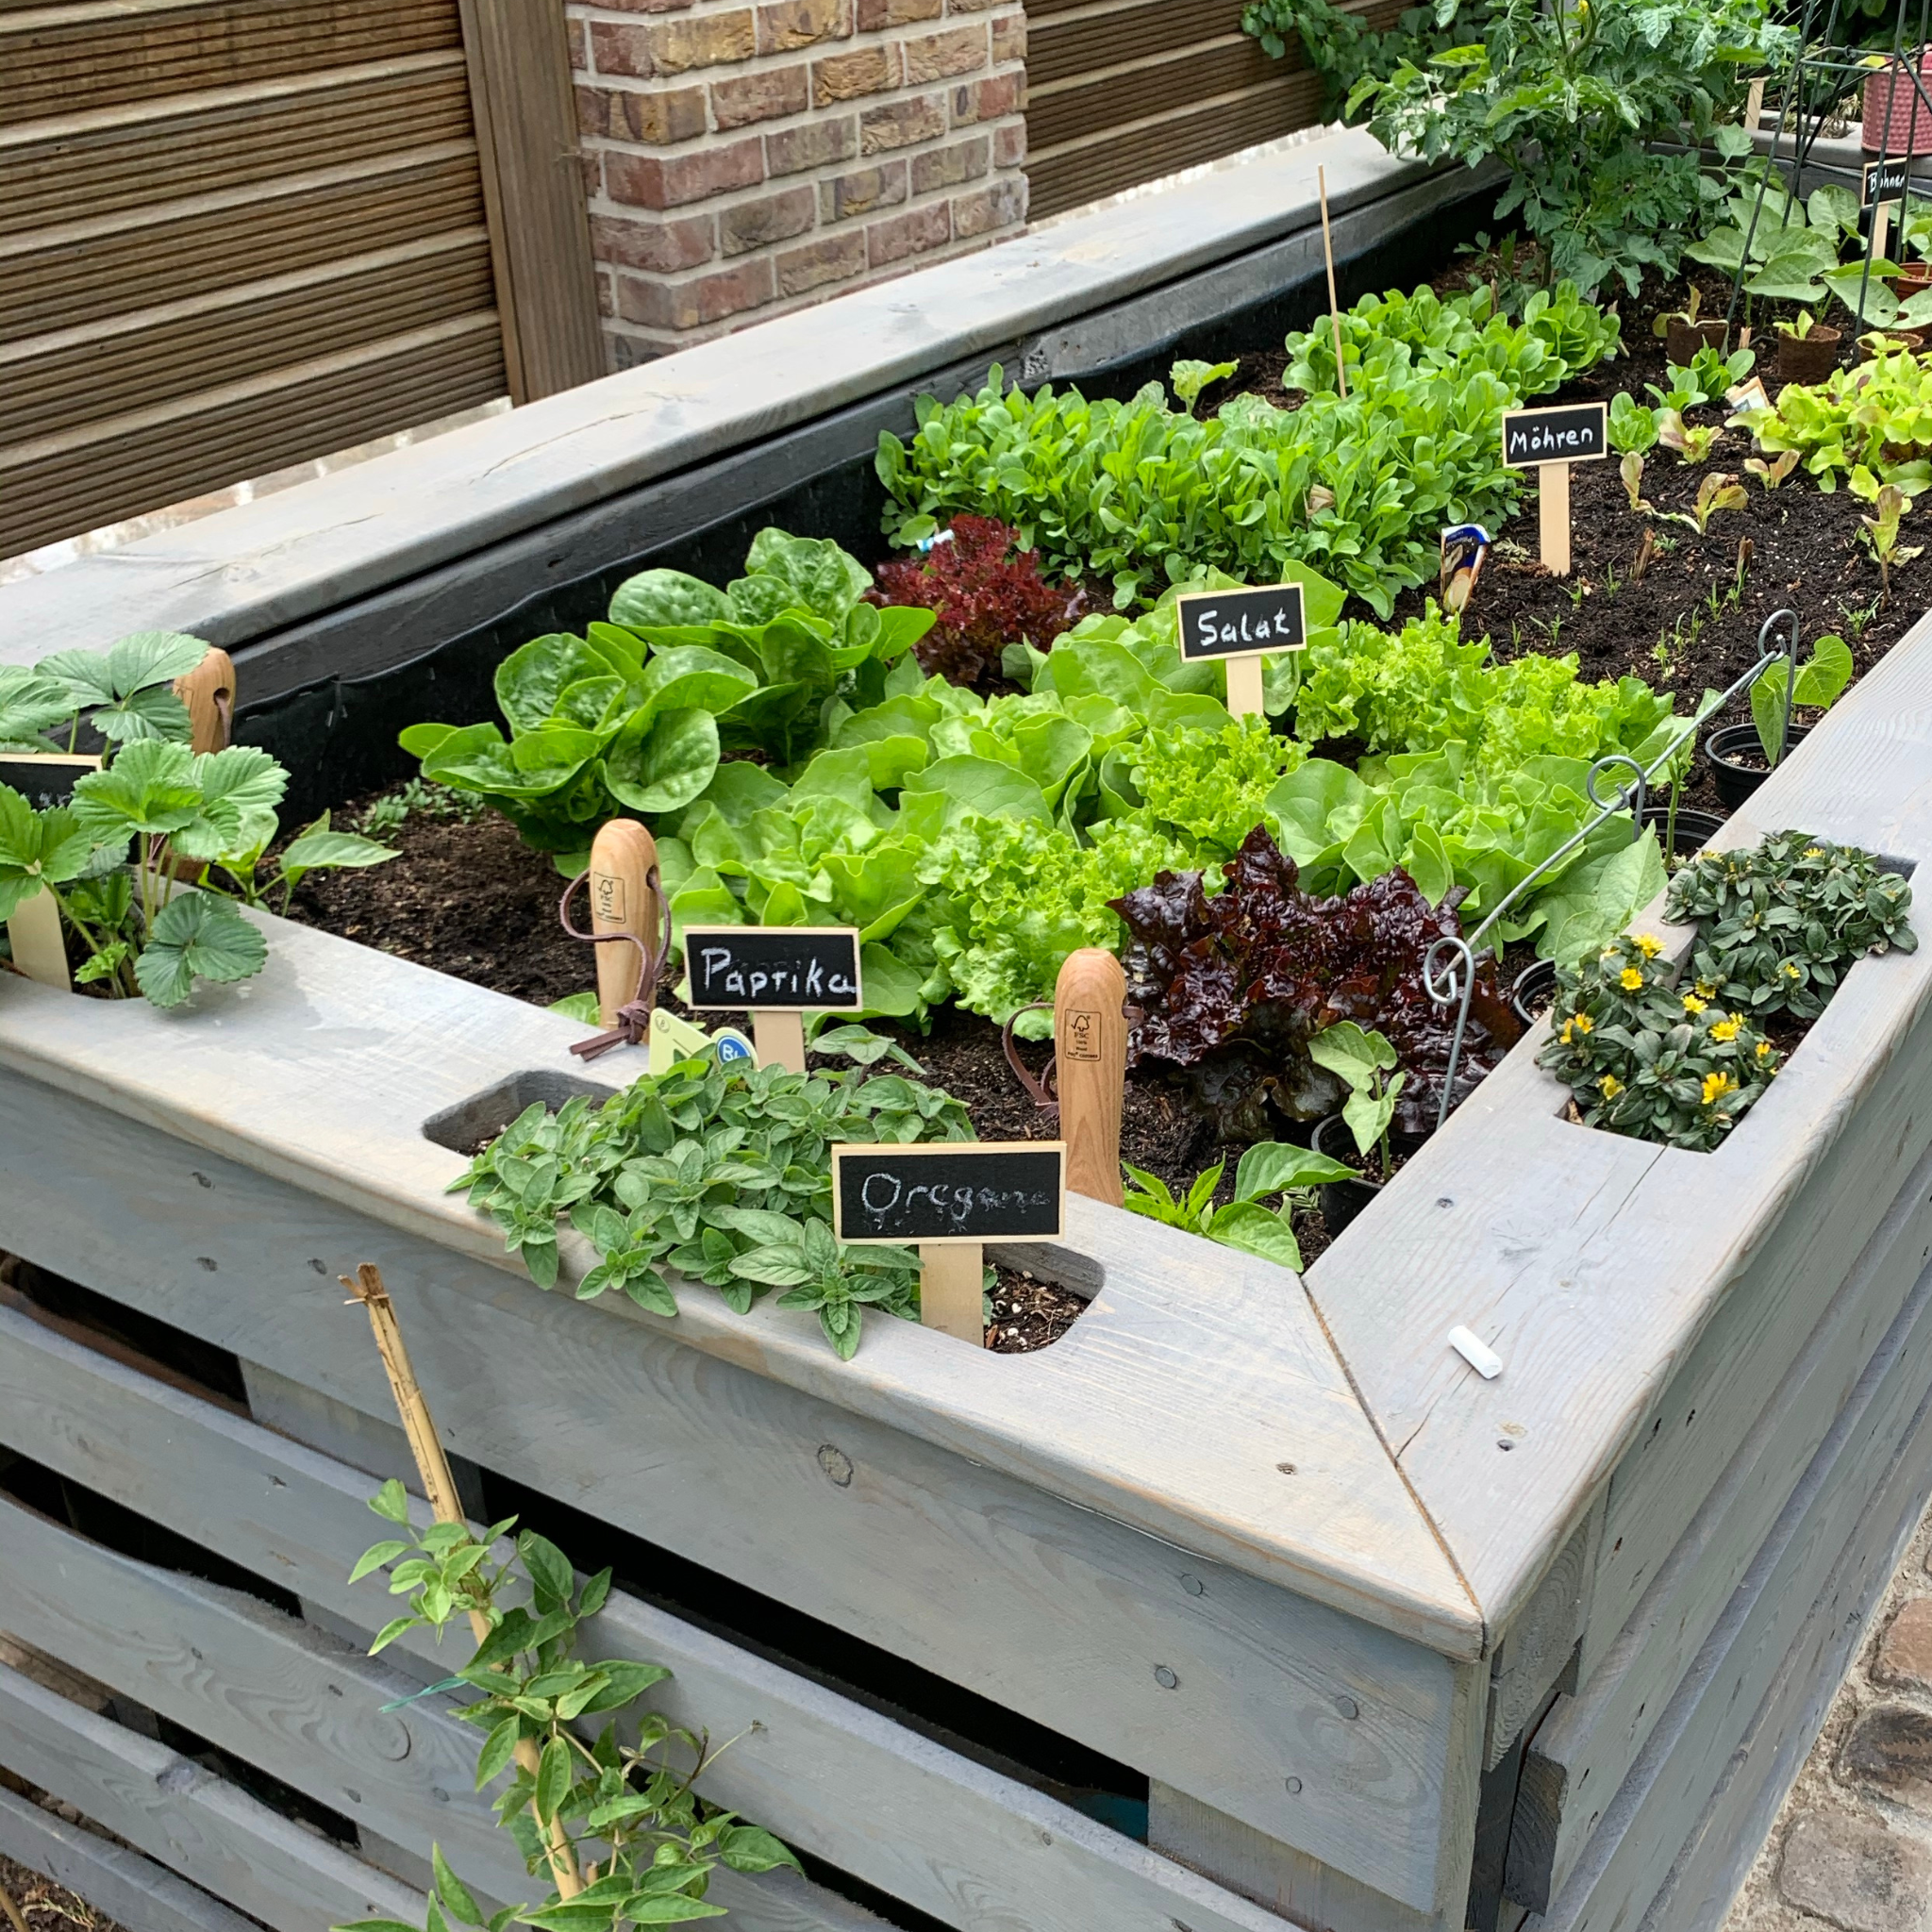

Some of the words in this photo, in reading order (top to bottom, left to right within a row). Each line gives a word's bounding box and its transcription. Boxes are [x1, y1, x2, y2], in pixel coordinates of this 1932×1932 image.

[1510, 425, 1593, 455] Möhren
[1198, 608, 1291, 646] Salat
[701, 947, 858, 999] Paprika
